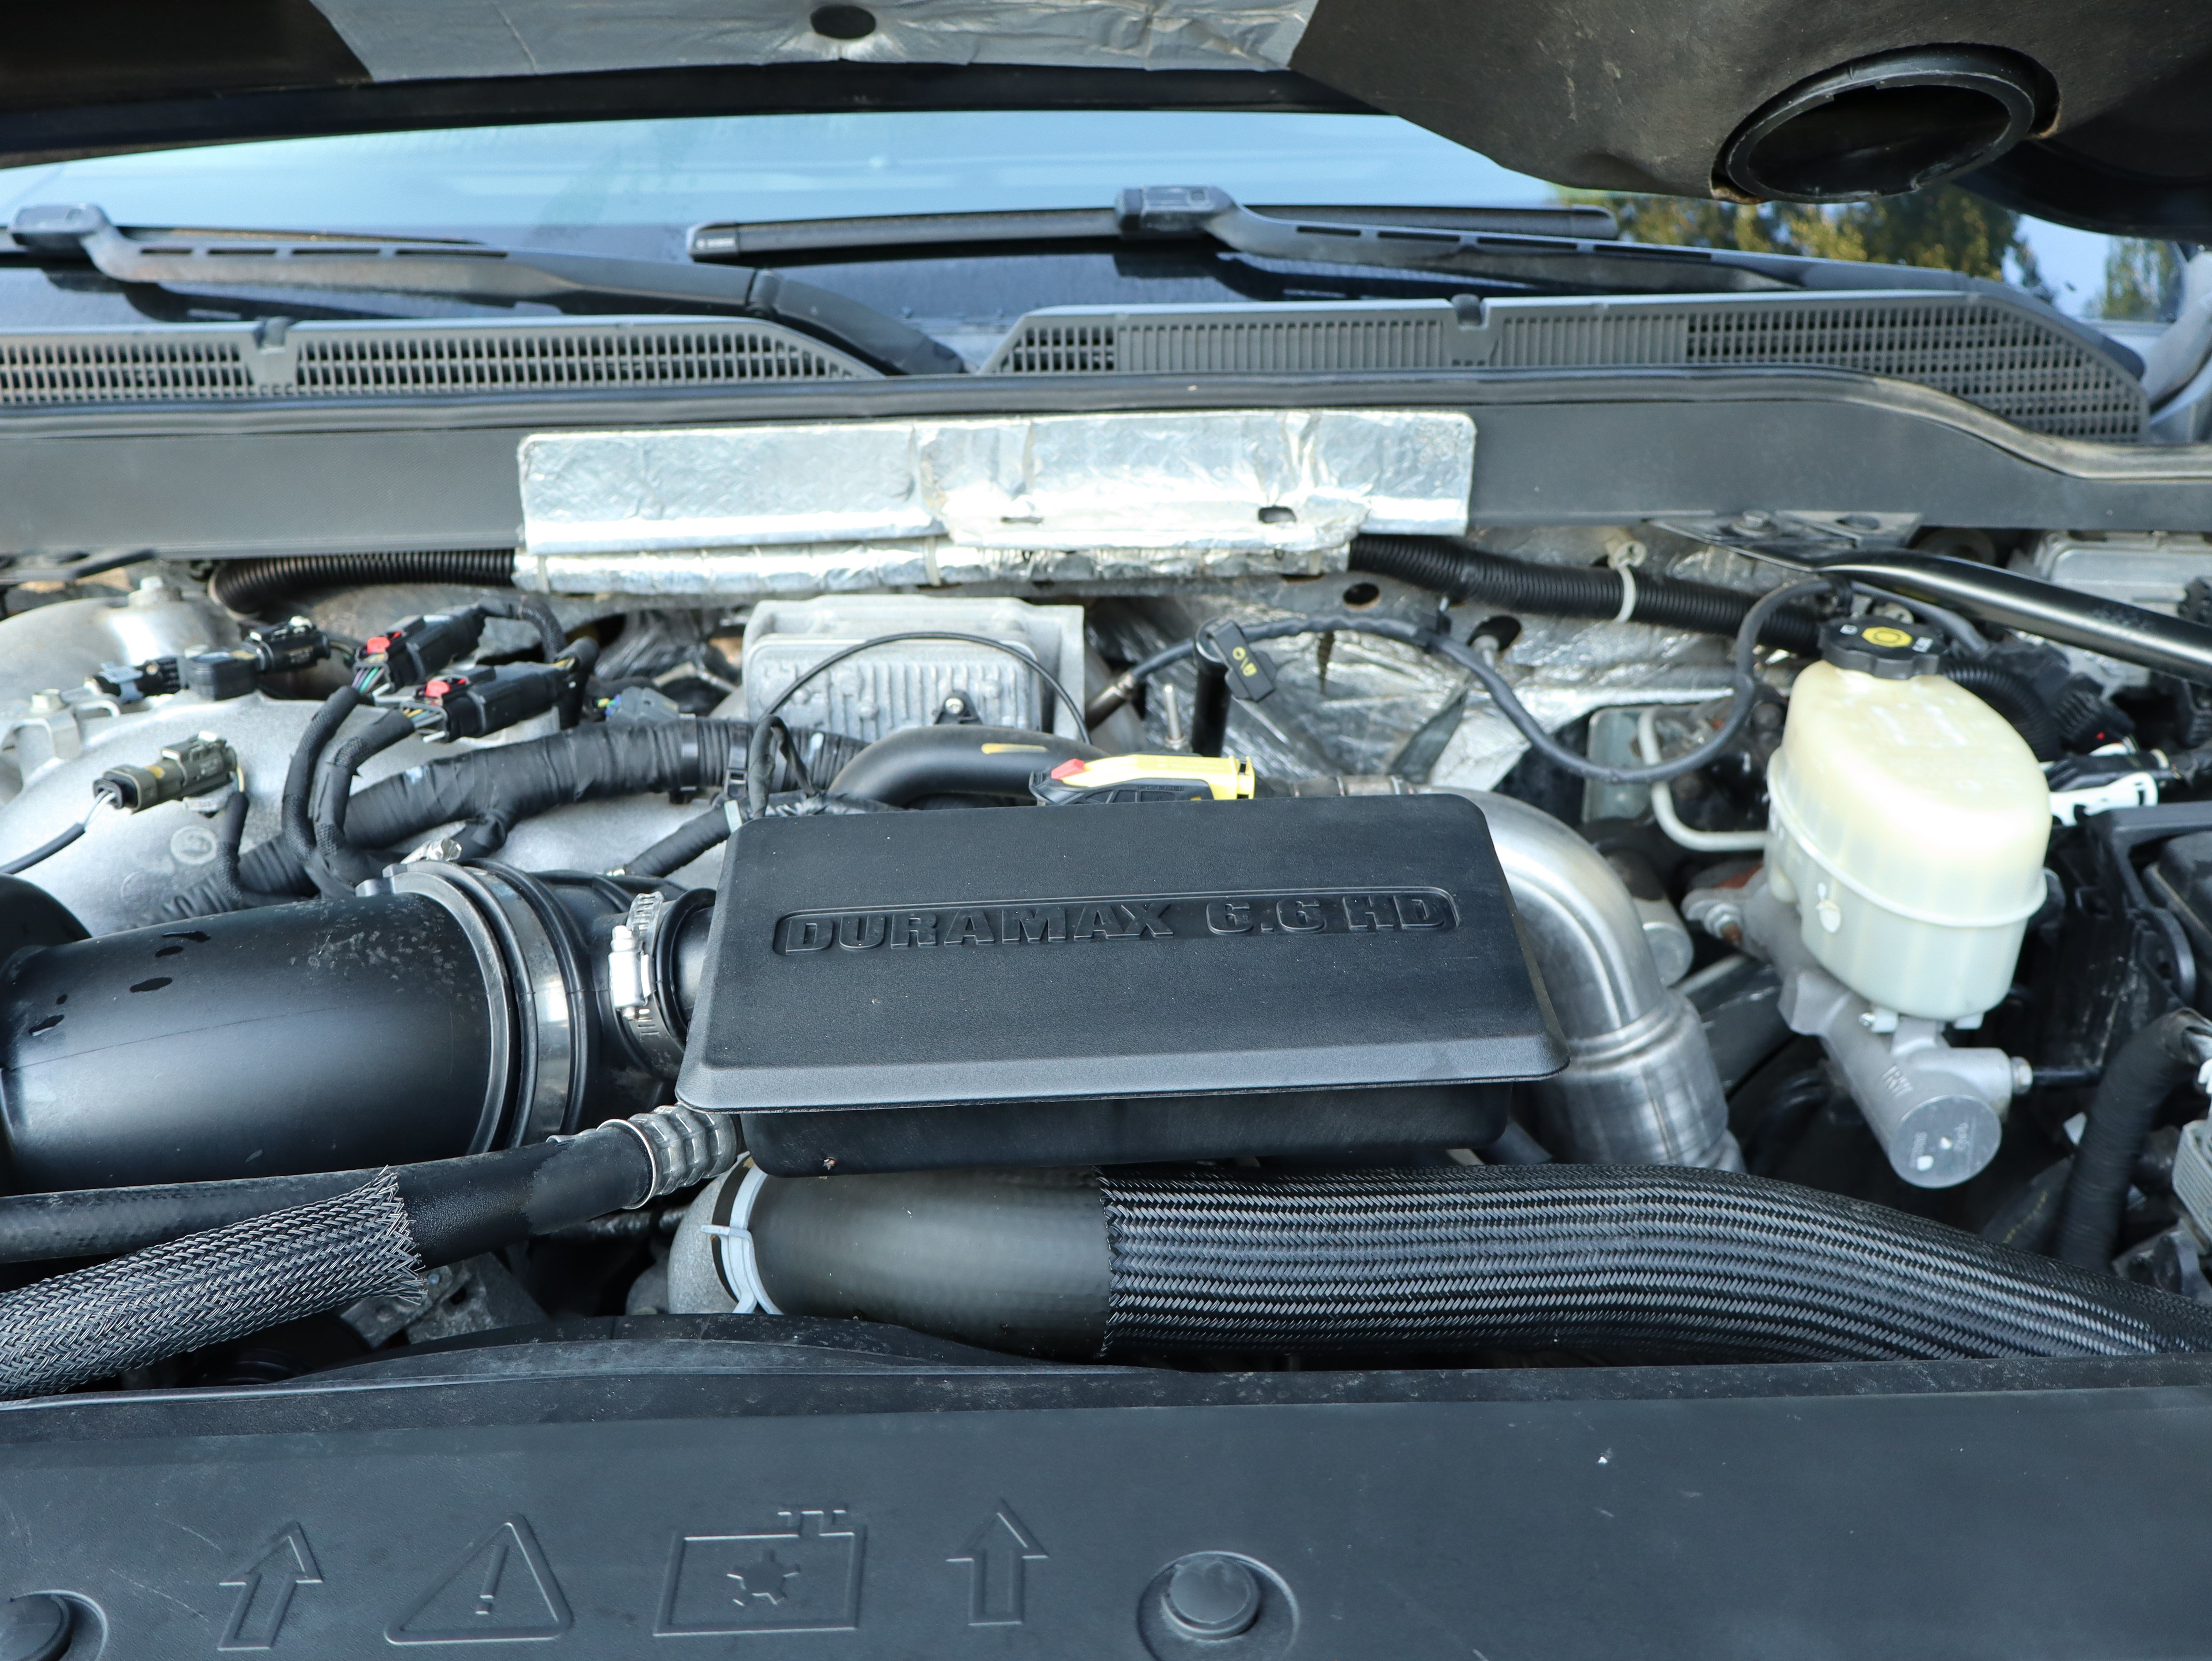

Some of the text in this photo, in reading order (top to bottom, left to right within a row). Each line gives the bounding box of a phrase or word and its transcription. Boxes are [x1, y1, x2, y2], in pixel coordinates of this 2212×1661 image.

[785, 894, 1446, 954] DURAMAX 6.6 HD
